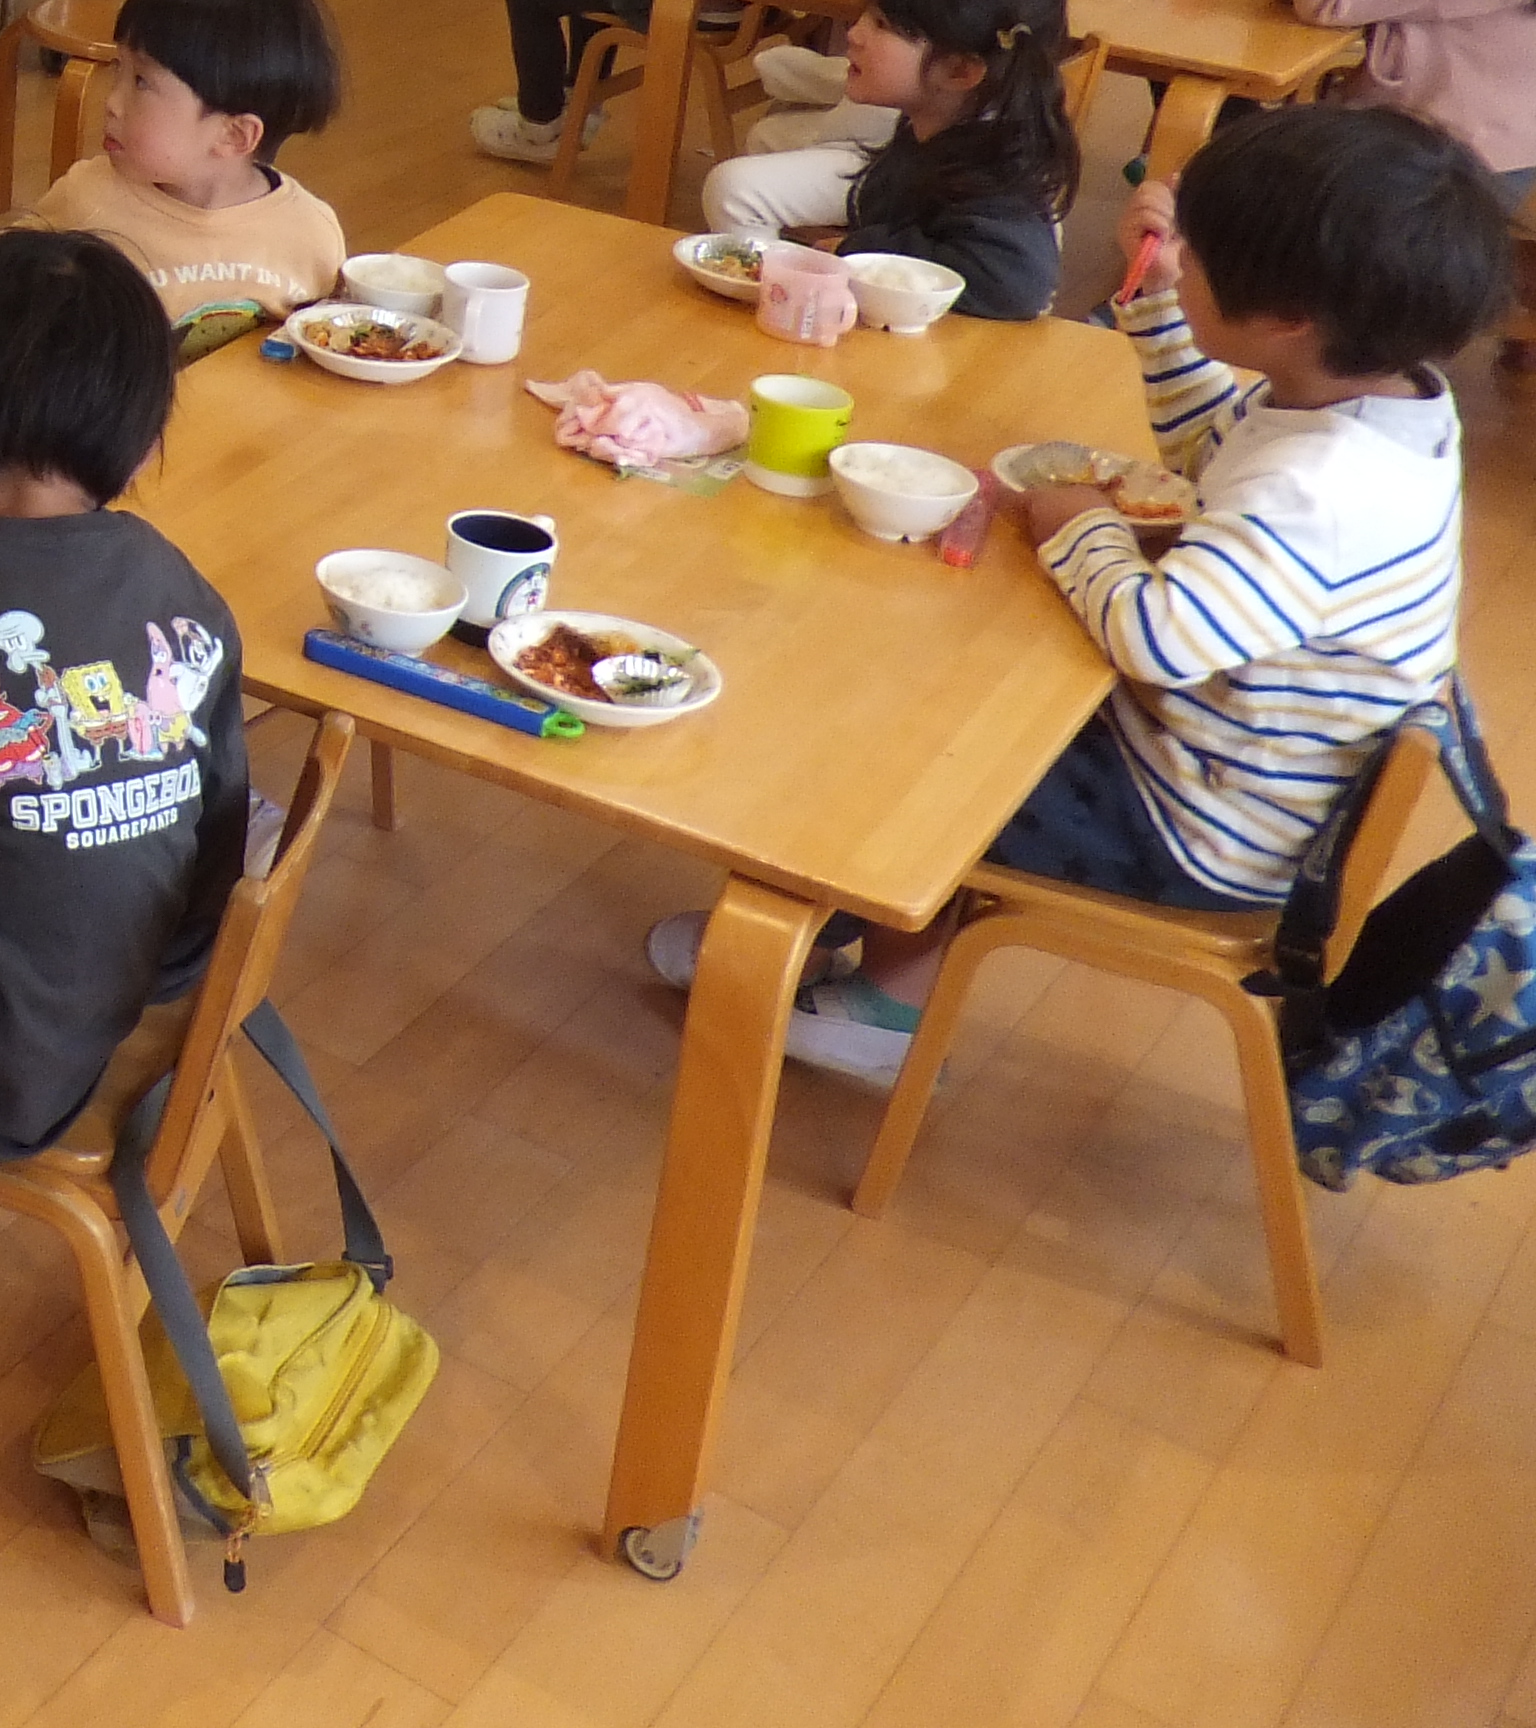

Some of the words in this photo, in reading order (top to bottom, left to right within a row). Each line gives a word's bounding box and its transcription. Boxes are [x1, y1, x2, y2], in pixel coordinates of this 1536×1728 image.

[174, 262, 252, 284] WANT
[257, 268, 281, 287] IN
[66, 807, 178, 850] SQUAREPANTS
